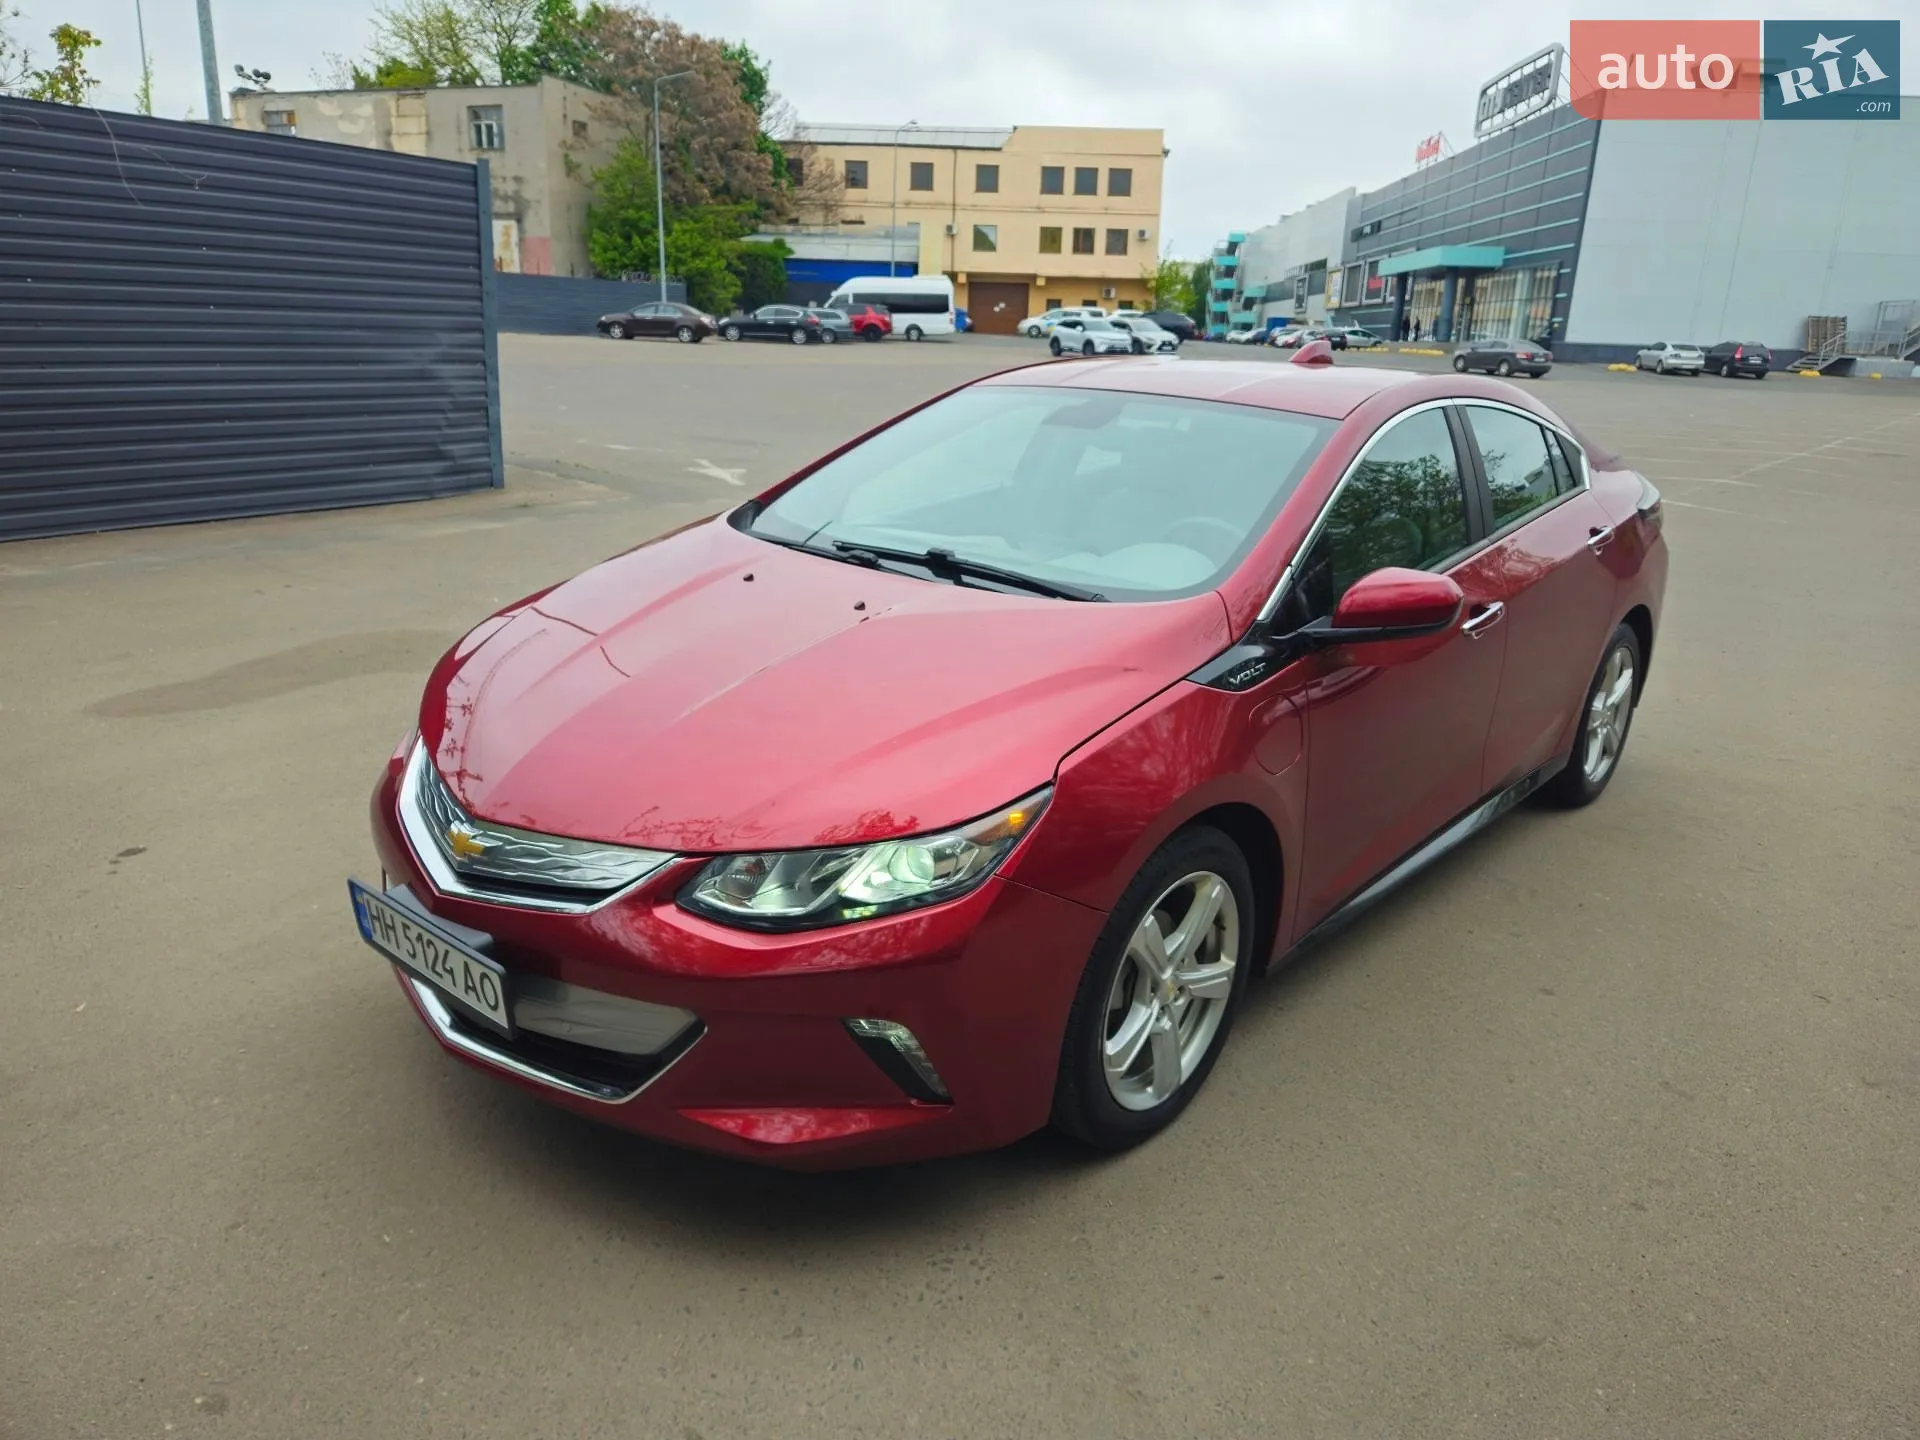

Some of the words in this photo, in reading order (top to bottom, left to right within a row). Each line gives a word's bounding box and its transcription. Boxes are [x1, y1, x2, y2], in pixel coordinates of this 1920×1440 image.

[1229, 662, 1266, 684] VOLT
[366, 898, 400, 950] HH
[401, 921, 457, 987] 5124
[463, 960, 499, 1012] AO
